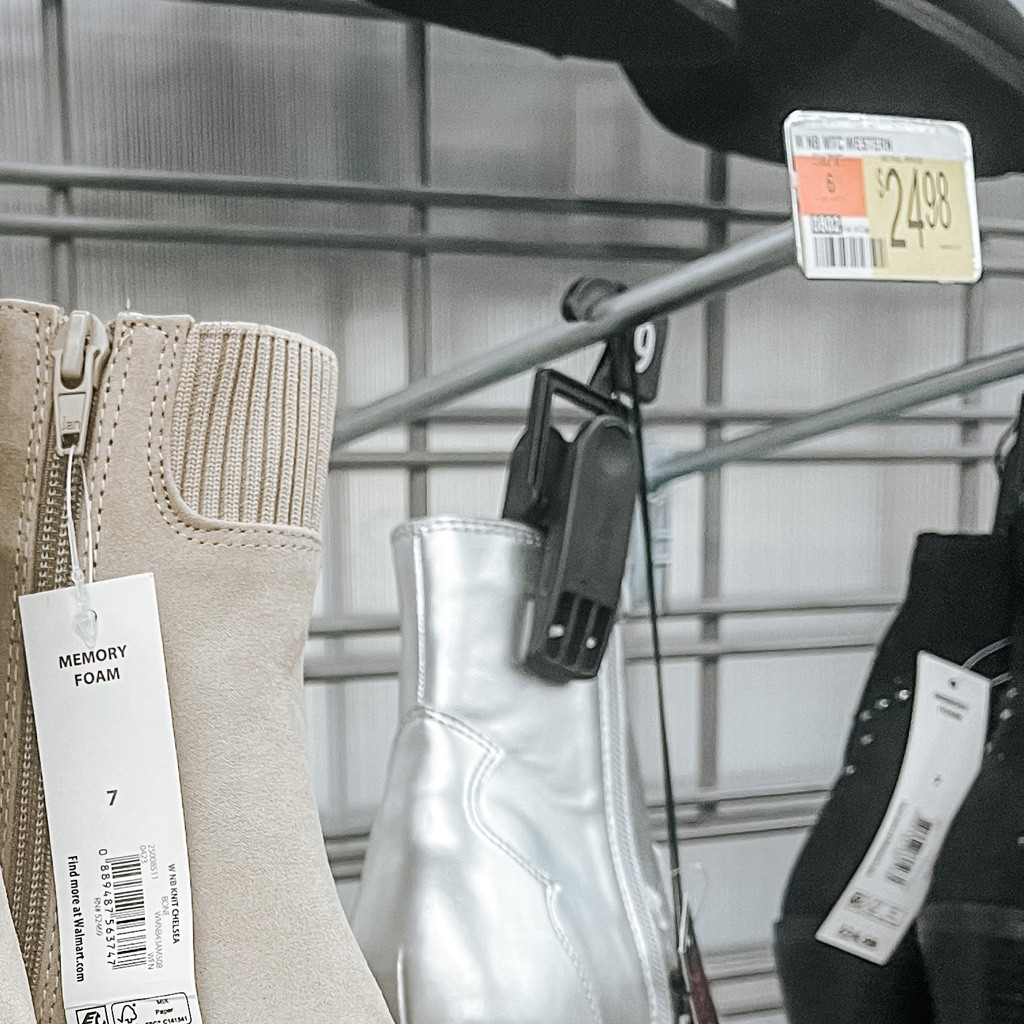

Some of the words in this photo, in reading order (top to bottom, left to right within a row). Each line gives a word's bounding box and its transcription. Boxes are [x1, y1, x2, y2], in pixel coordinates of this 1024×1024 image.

[825, 173, 837, 193] 6
[634, 321, 657, 374] 9
[58, 644, 128, 668] MEMORY
[74, 666, 121, 687] FOAM
[106, 789, 119, 807] 7
[98, 848, 108, 856] 0
[68, 855, 81, 877] Find
[168, 863, 177, 873] W
[100, 864, 114, 913] 889487
[169, 874, 178, 887] NB
[70, 879, 81, 905] more
[170, 887, 179, 907] KNIT
[73, 907, 82, 917] at
[161, 896, 170, 917] BONE
[171, 908, 181, 945] CHELSEA
[74, 917, 86, 983] Walmart.com
[105, 918, 116, 966] 563747
[154, 1007, 174, 1016] Paper
